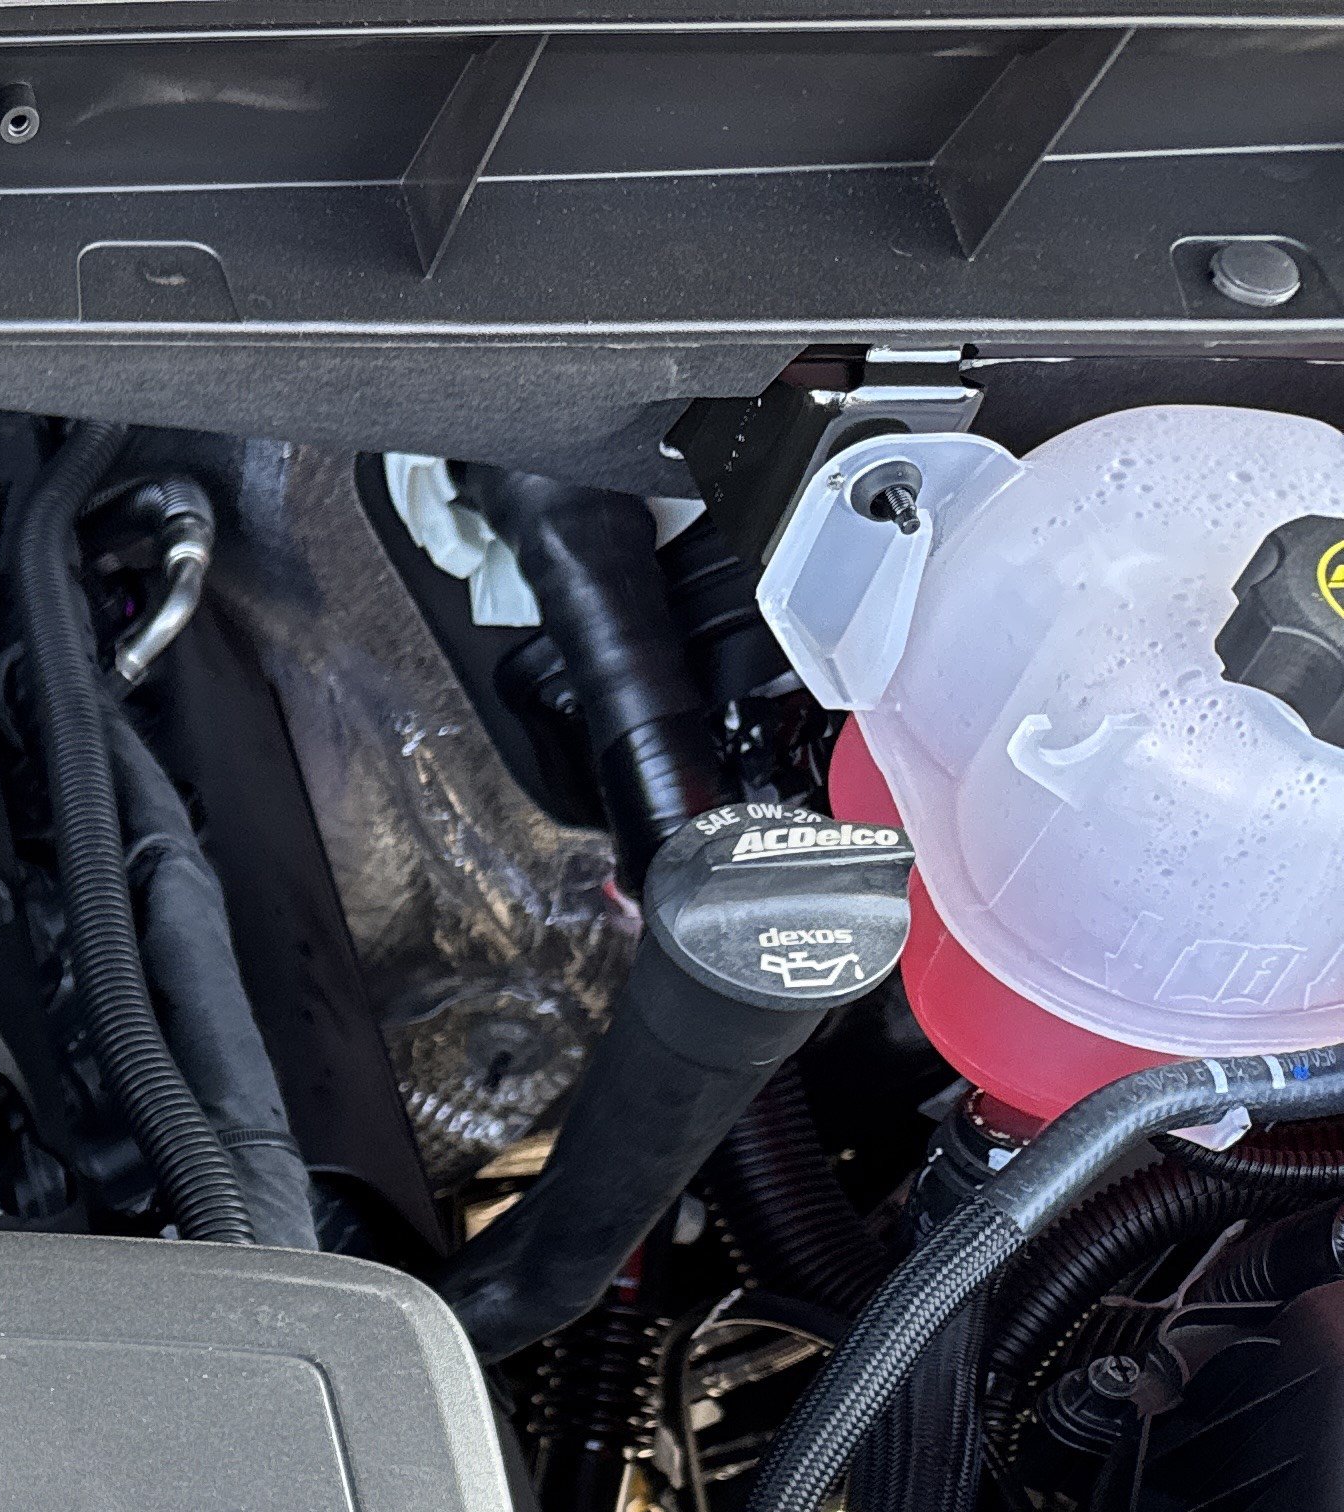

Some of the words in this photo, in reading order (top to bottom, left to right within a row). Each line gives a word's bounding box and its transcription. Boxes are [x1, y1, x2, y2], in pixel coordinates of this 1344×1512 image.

[695, 806, 741, 835] SAE
[731, 824, 899, 856] ACDelco
[758, 927, 853, 948] dexos
